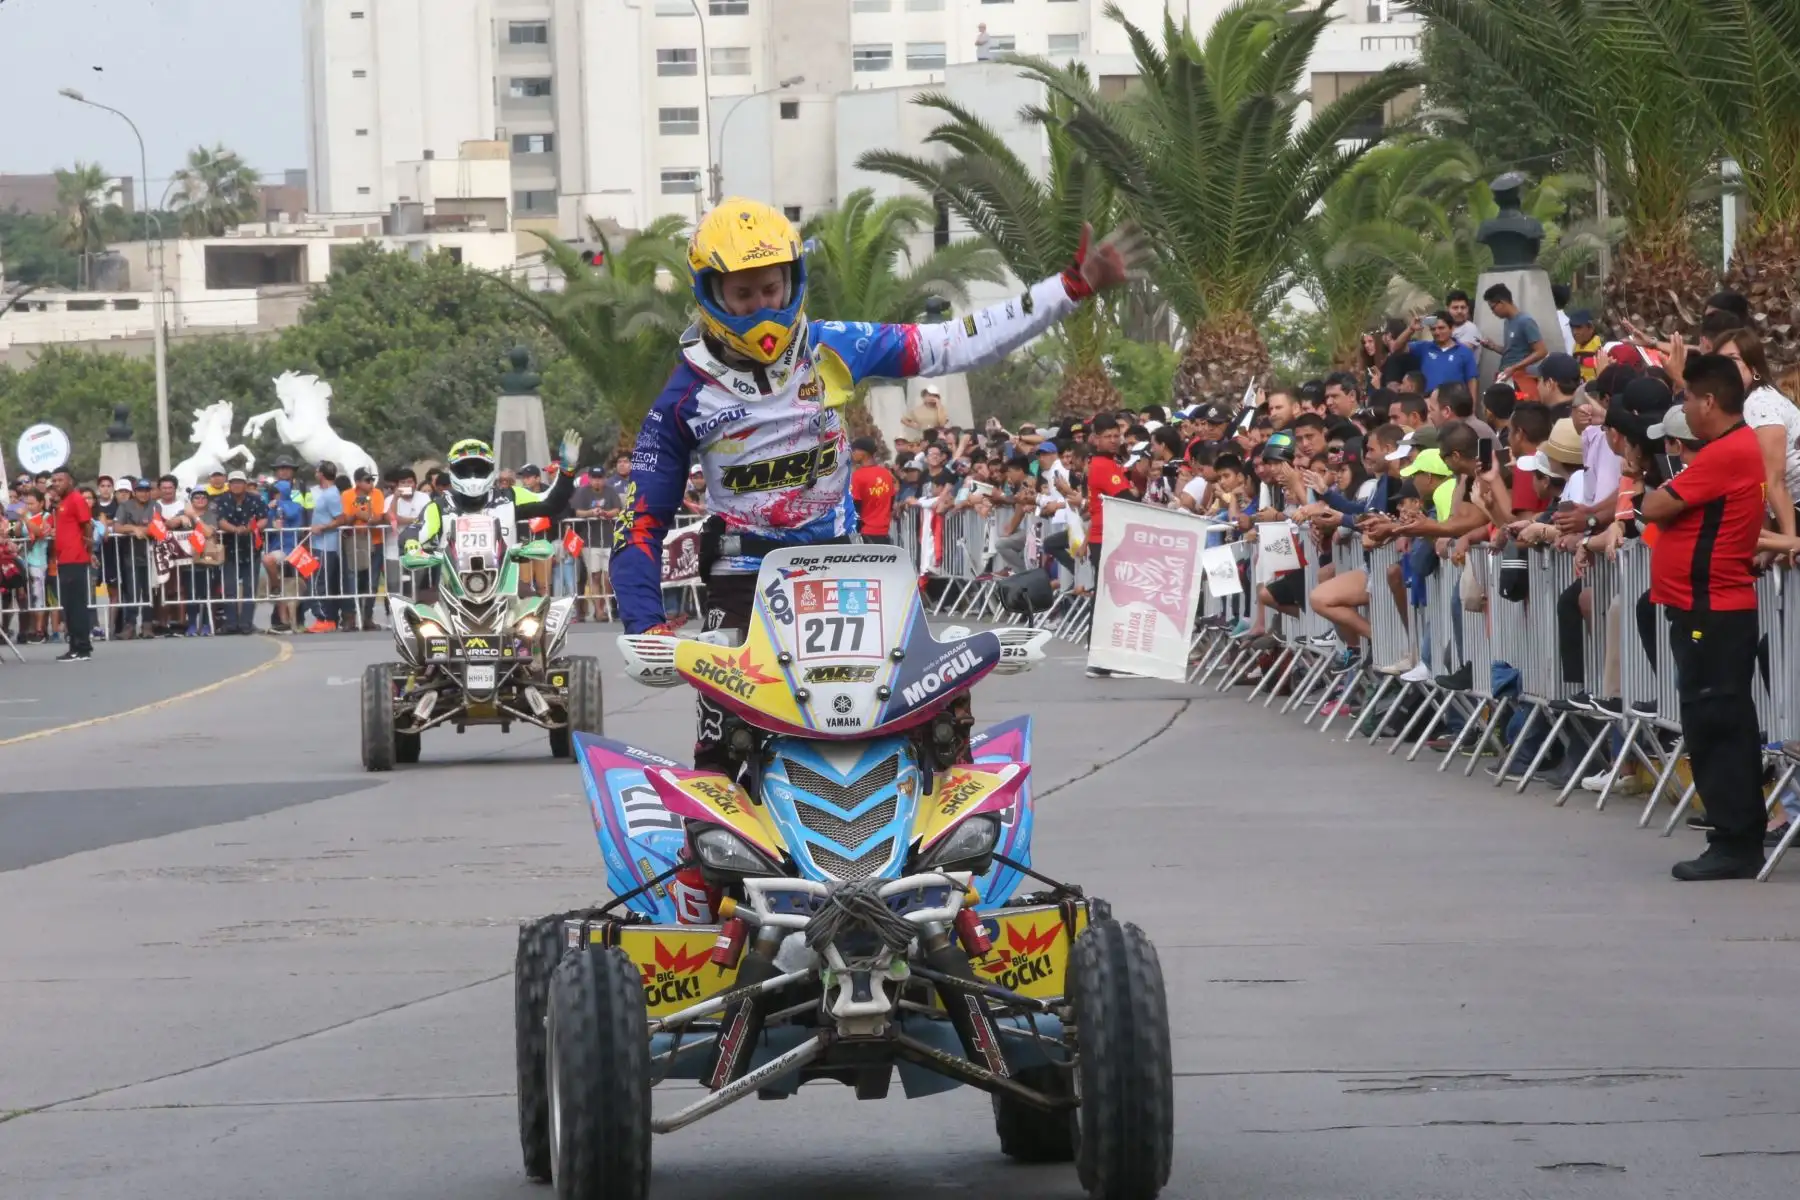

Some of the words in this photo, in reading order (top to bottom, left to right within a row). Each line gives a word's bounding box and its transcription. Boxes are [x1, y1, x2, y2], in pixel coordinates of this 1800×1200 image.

[733, 377, 756, 395] VOP
[695, 408, 752, 438] MOGUL
[462, 534, 487, 547] 278
[790, 557, 820, 566] Olga
[765, 578, 794, 625] VOP
[805, 617, 864, 653] 277
[456, 648, 499, 656] ENRICO
[939, 641, 967, 662] PARAMO
[692, 658, 756, 700] SHOCK!
[902, 649, 983, 707] MOGUL
[826, 717, 861, 728] YAMAHA
[690, 781, 740, 814] SHOCK!
[941, 780, 985, 816] SHOCK!
[994, 954, 1053, 992] OCK!
[1012, 952, 1028, 966] BIG
[645, 975, 701, 1006] OCK!
[657, 970, 674, 982] BIG
